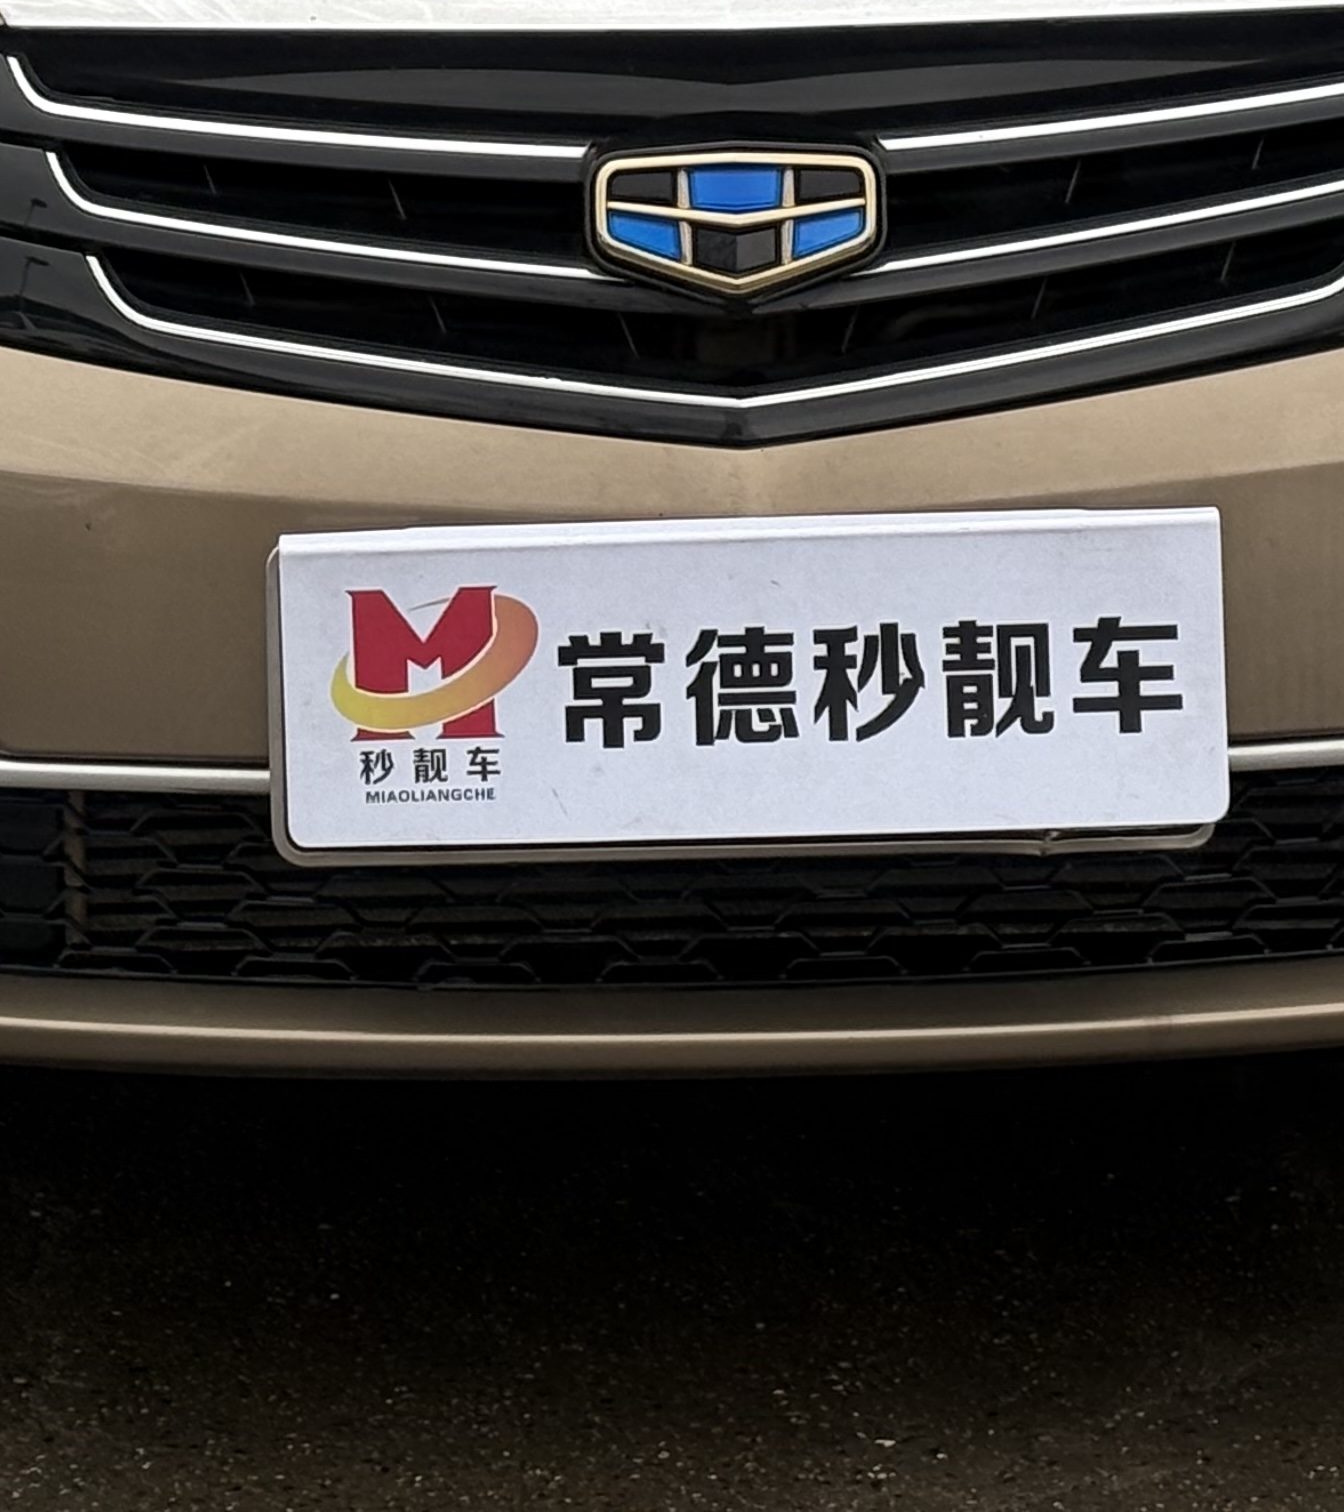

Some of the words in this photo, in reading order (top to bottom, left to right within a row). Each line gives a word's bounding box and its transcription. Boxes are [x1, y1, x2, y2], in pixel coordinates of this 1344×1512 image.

[557, 616, 1183, 748] 常德秒靓车
[359, 746, 502, 785] 秒靓车
[365, 787, 496, 804] MIAOLIANGCHE
